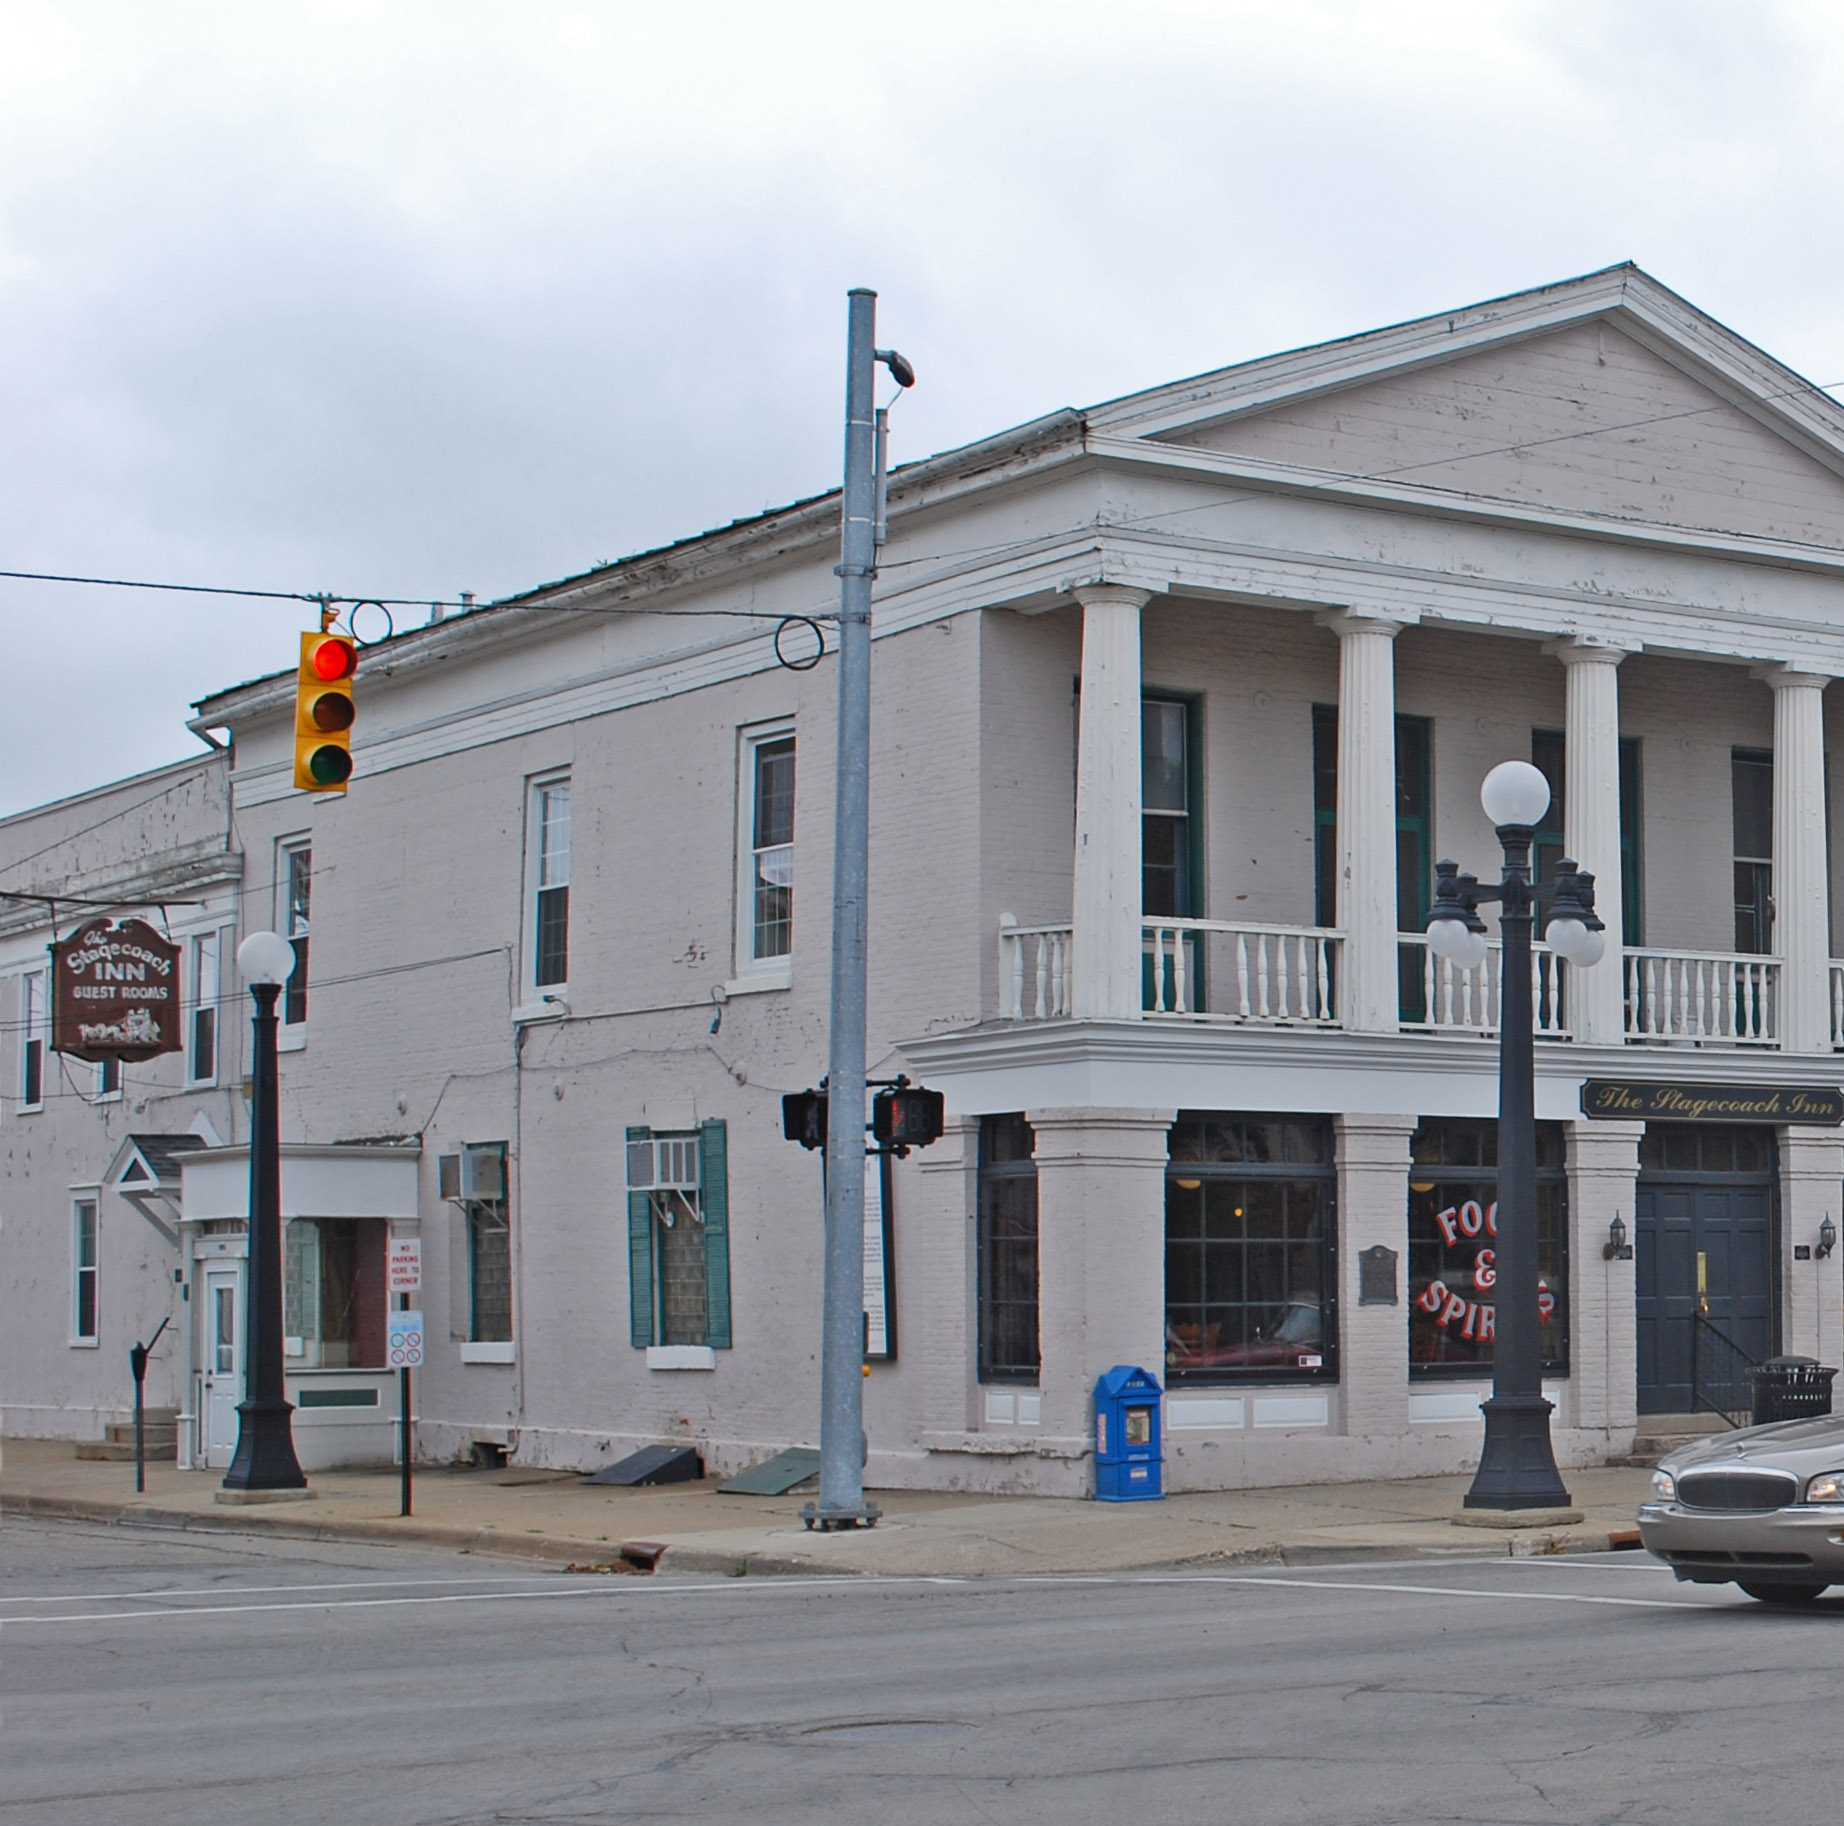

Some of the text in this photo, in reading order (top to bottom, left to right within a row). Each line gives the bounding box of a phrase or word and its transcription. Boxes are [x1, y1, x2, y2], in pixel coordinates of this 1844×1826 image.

[67, 943, 171, 976] Stagecoach
[95, 962, 146, 981] INN
[73, 986, 168, 999] GUEST ROOMS
[1596, 1086, 1835, 1118] The Stagecoach Inn
[392, 1255, 418, 1263] PARKING
[1473, 1248, 1497, 1291] &
[393, 1277, 418, 1285] CORNER
